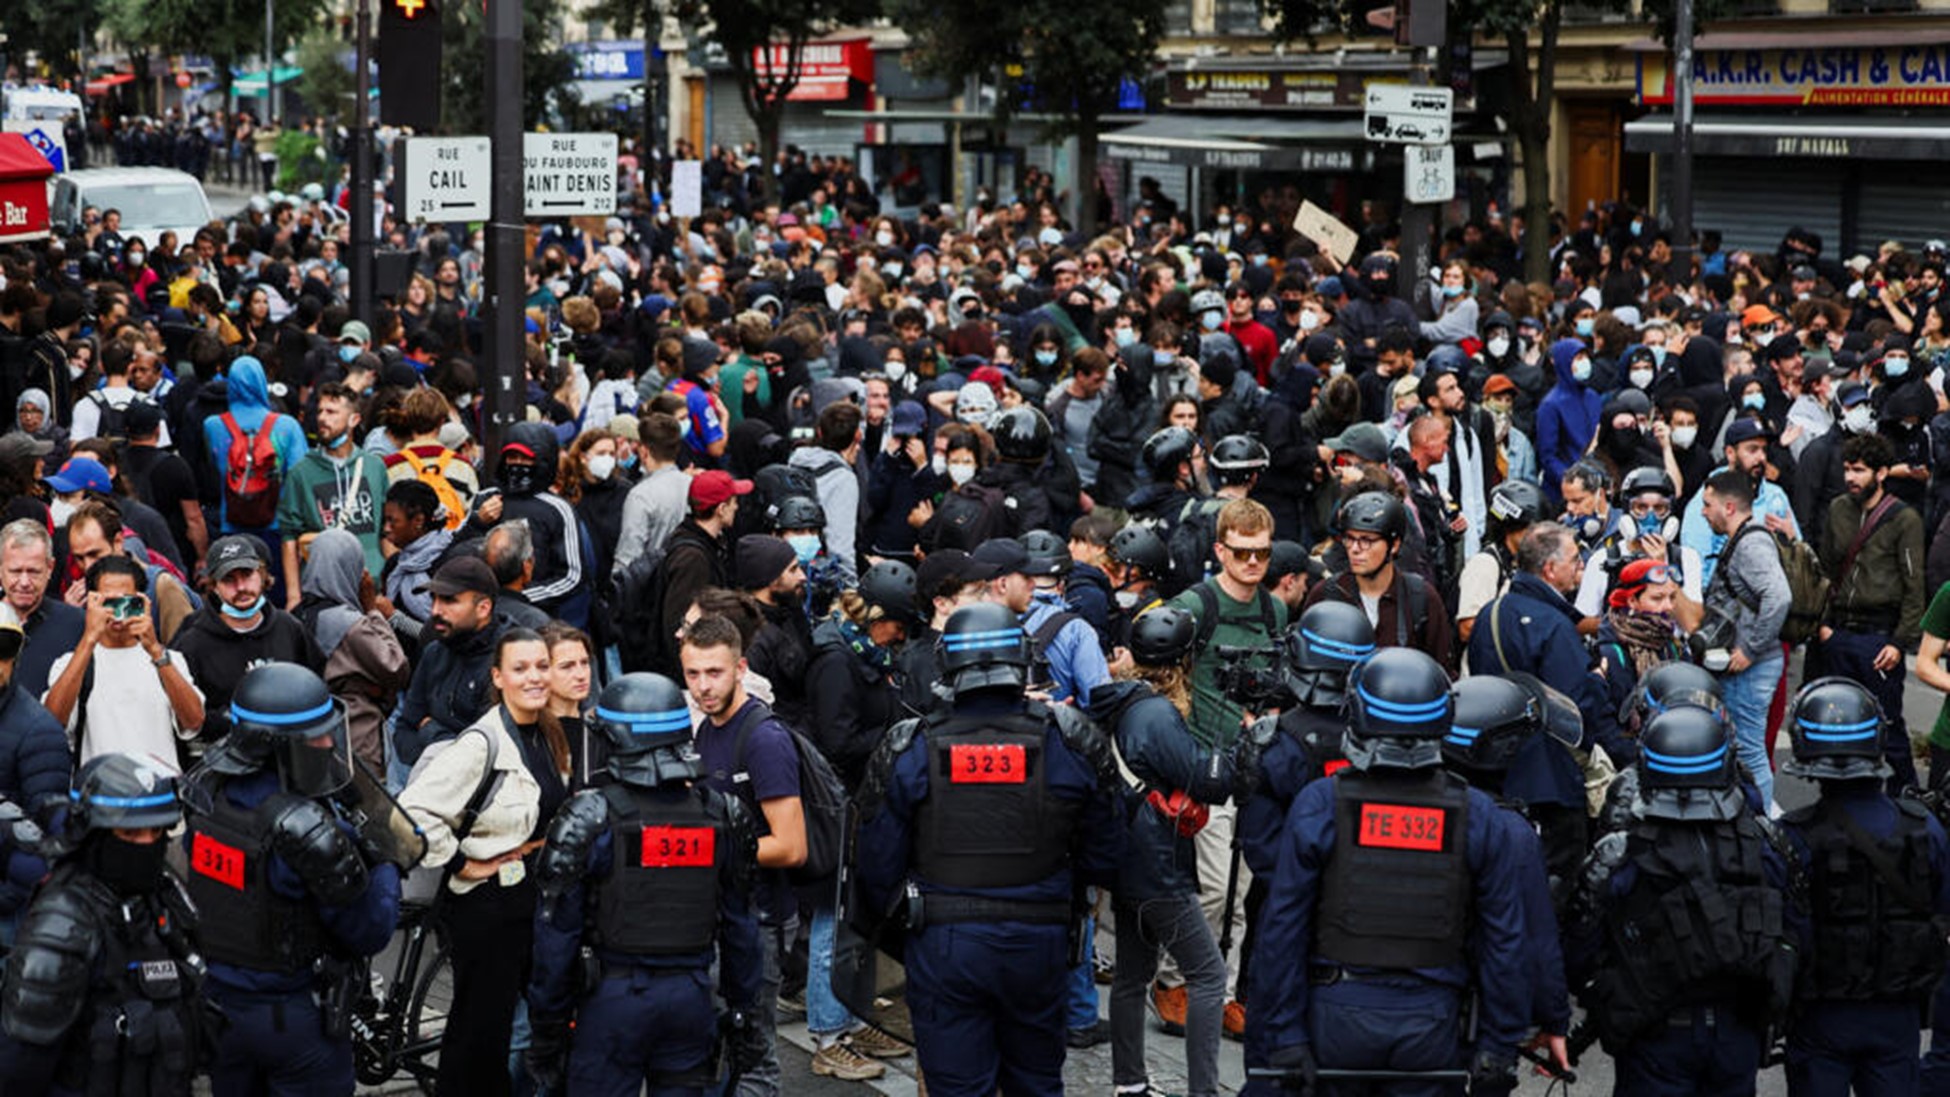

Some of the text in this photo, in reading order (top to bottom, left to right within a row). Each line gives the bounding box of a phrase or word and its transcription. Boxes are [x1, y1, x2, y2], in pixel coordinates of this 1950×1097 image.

[1693, 48, 1770, 84] A.K.R.
[1780, 48, 1859, 84] CASH
[1869, 47, 1889, 84] &
[1211, 73, 1270, 90] TRADERS
[1812, 91, 1888, 105] ALIMENTATION
[438, 147, 459, 160] RUE
[553, 140, 577, 151] RUE
[542, 157, 608, 169] FAUBOURG
[429, 170, 468, 189] CAIL
[527, 174, 611, 192] AINT DENIS
[5, 201, 27, 225] Bar
[421, 199, 434, 212] 25
[966, 755, 1011, 773] 323
[1366, 813, 1439, 840] TE 332
[660, 838, 698, 856] 321
[204, 848, 232, 876] 321
